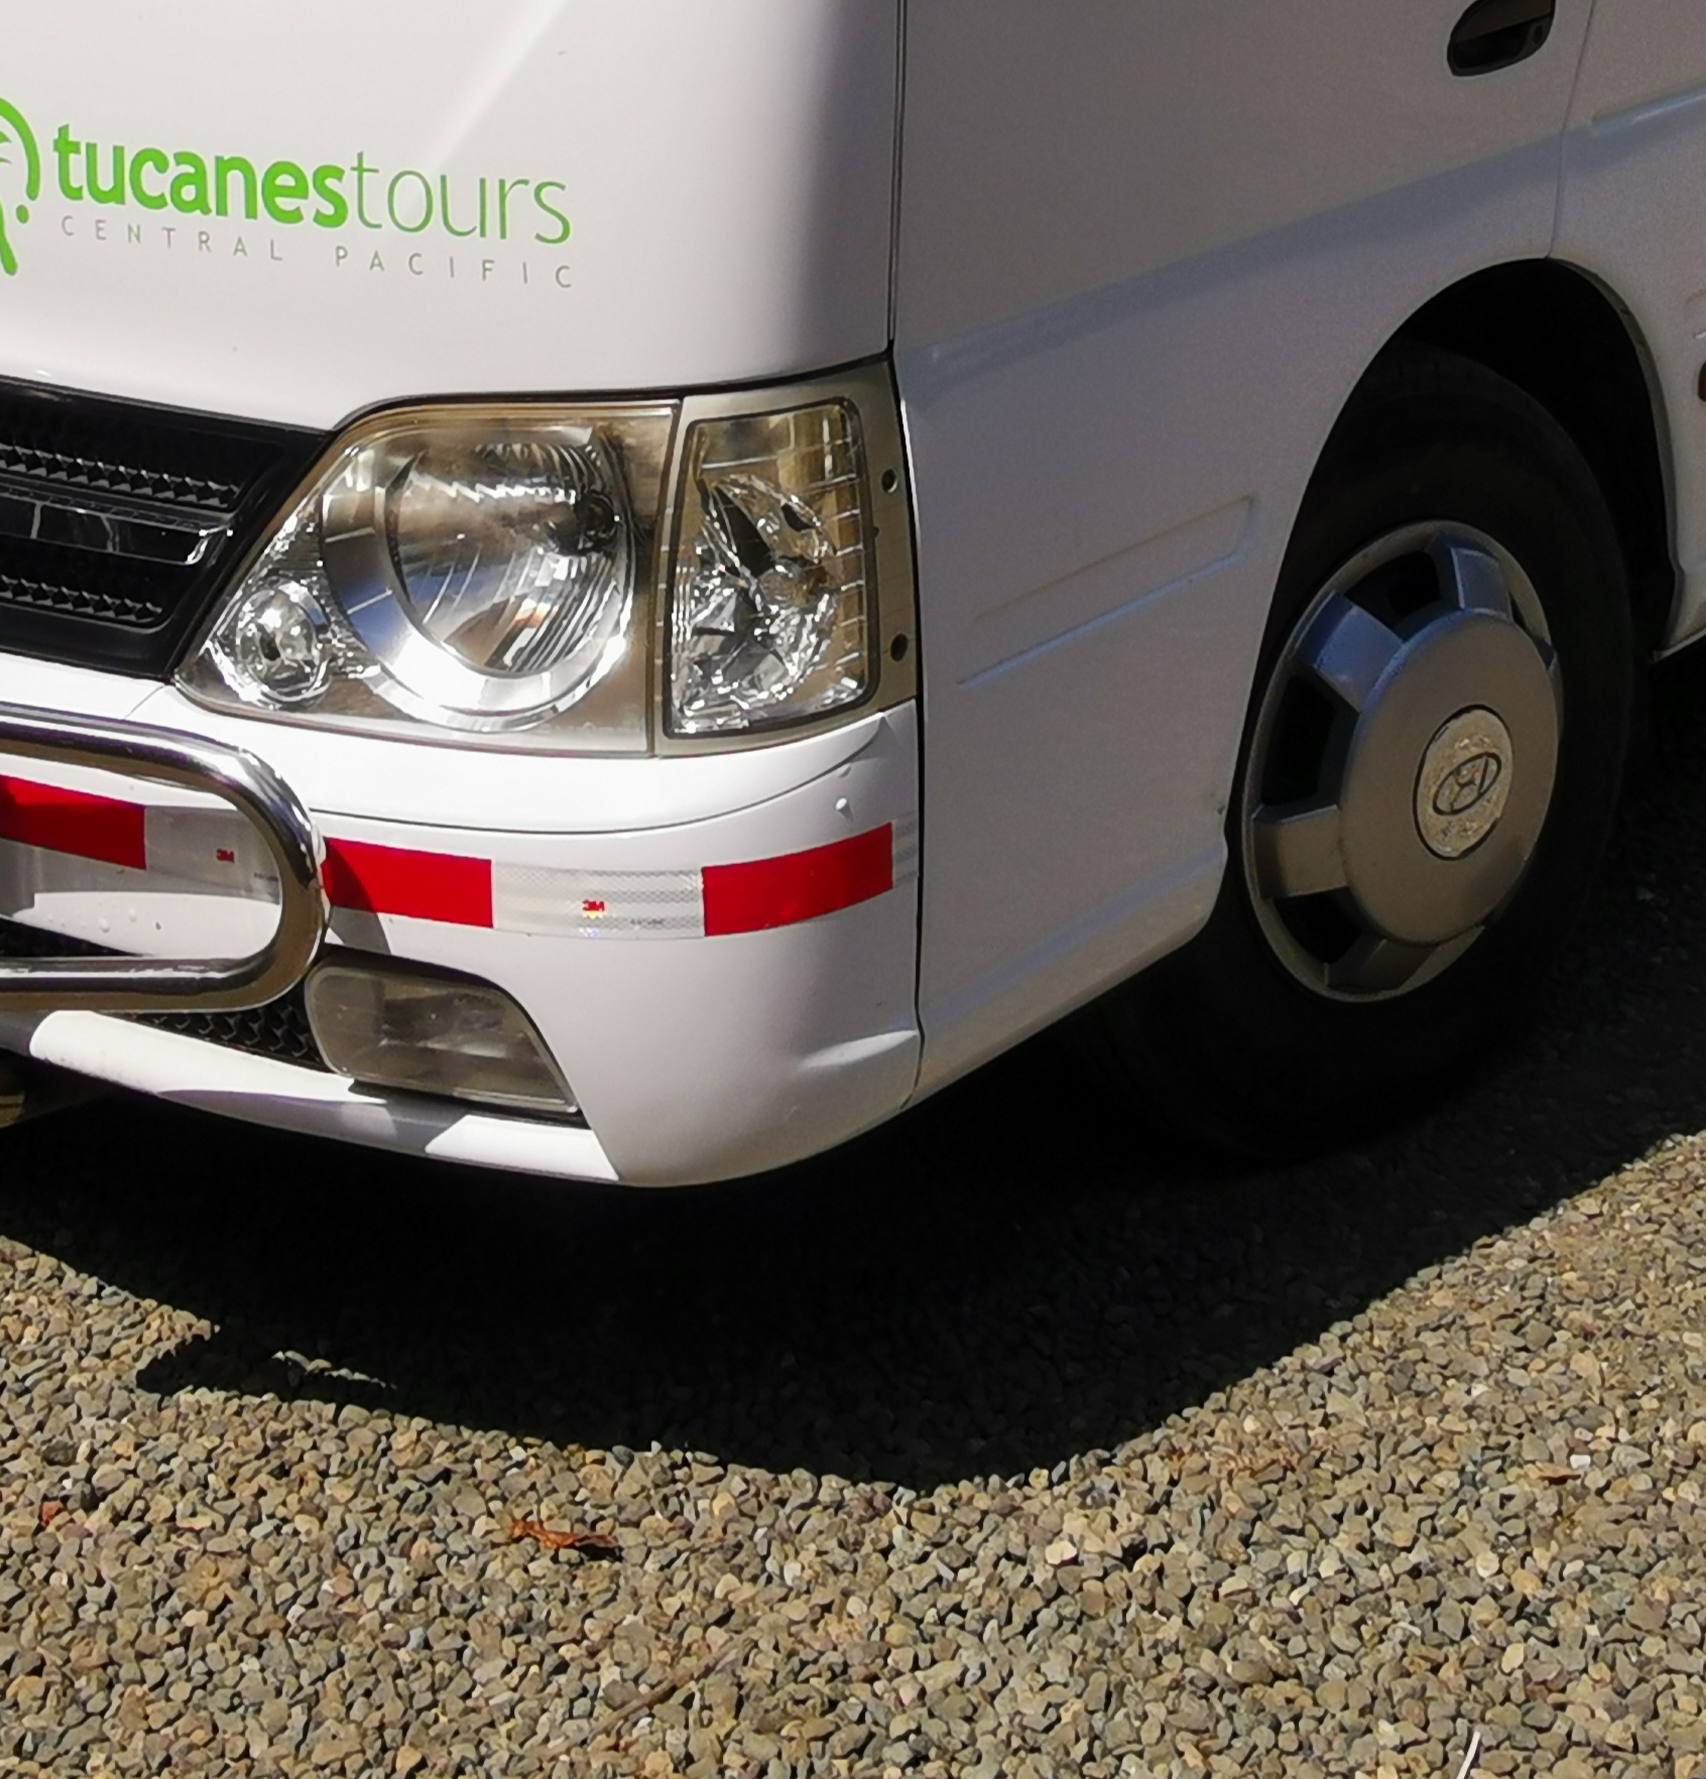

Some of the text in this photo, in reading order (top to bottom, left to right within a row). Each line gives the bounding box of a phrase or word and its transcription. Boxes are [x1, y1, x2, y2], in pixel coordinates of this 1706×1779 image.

[53, 123, 573, 246] tucanestours
[61, 214, 573, 290] CENTRAL PACIFIC
